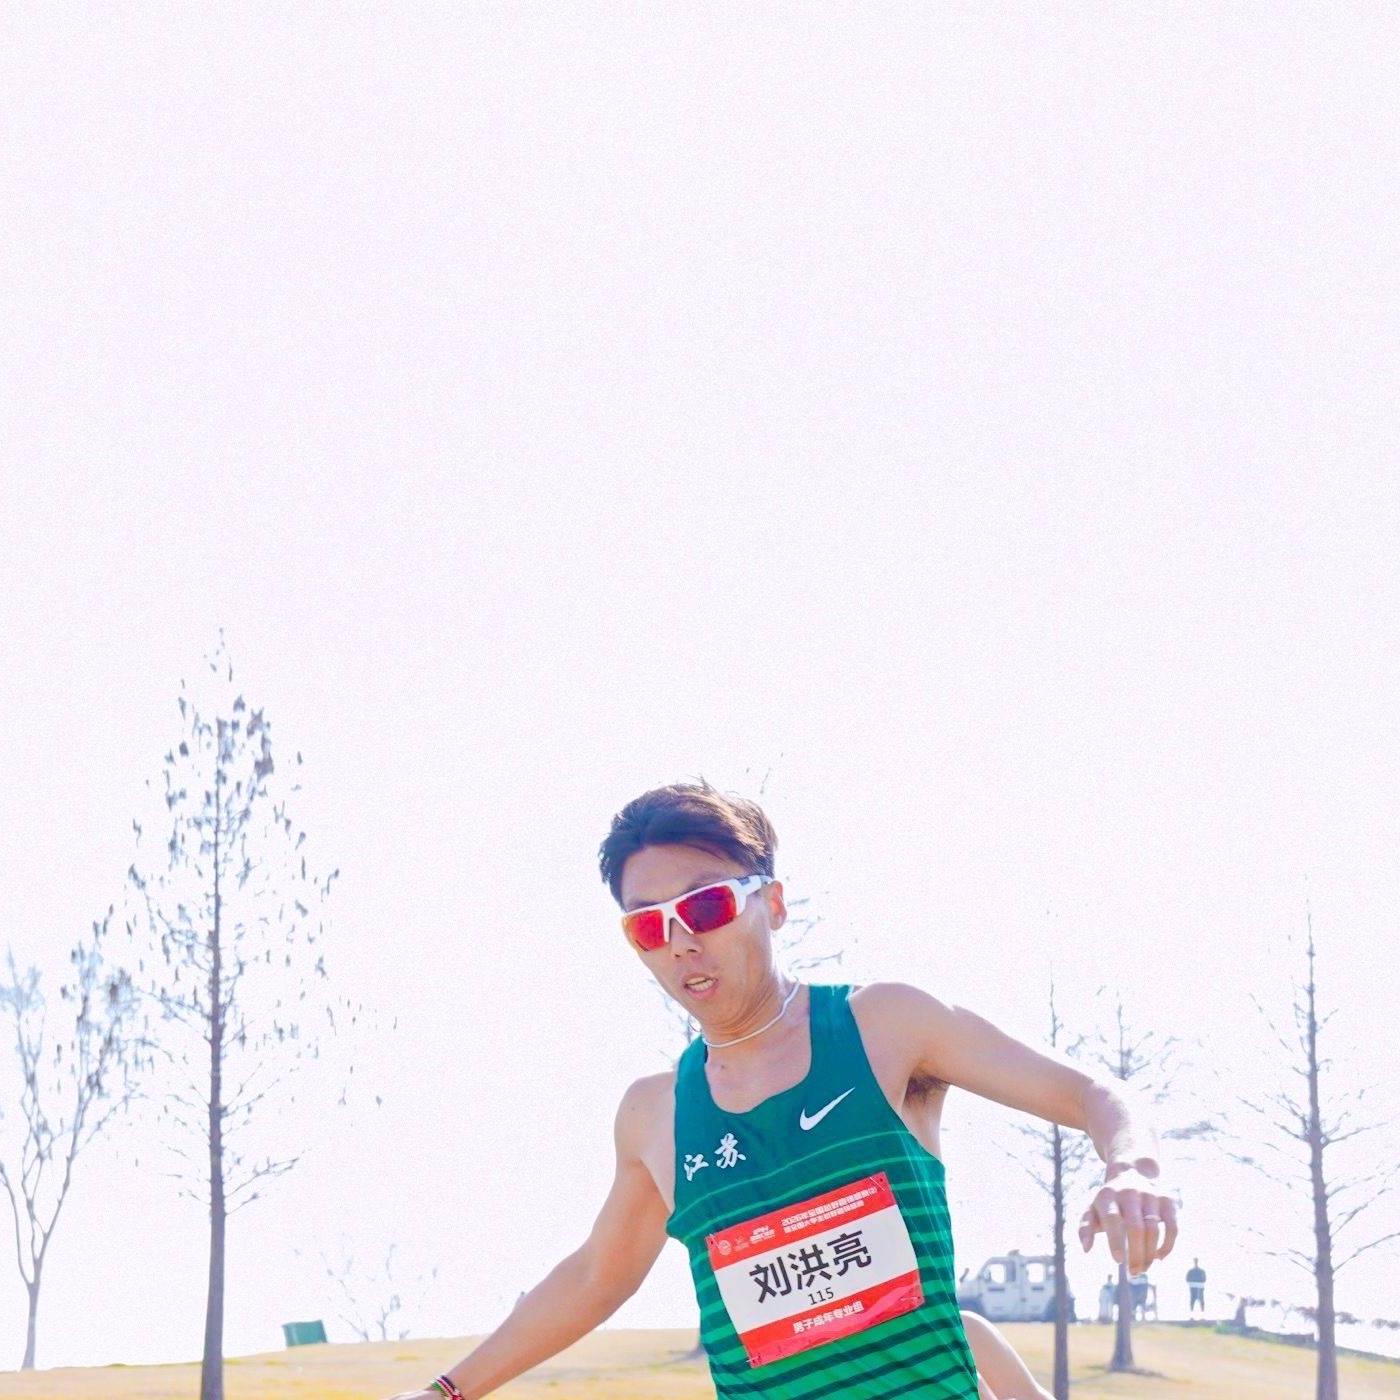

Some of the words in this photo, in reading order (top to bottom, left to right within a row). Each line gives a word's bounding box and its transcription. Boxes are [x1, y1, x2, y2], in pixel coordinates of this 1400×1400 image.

[683, 1132, 747, 1182] 江苏
[748, 1230, 873, 1304] 刘洪亮
[792, 1300, 865, 1334] 男子成年专业组
[807, 1286, 835, 1306] 115
